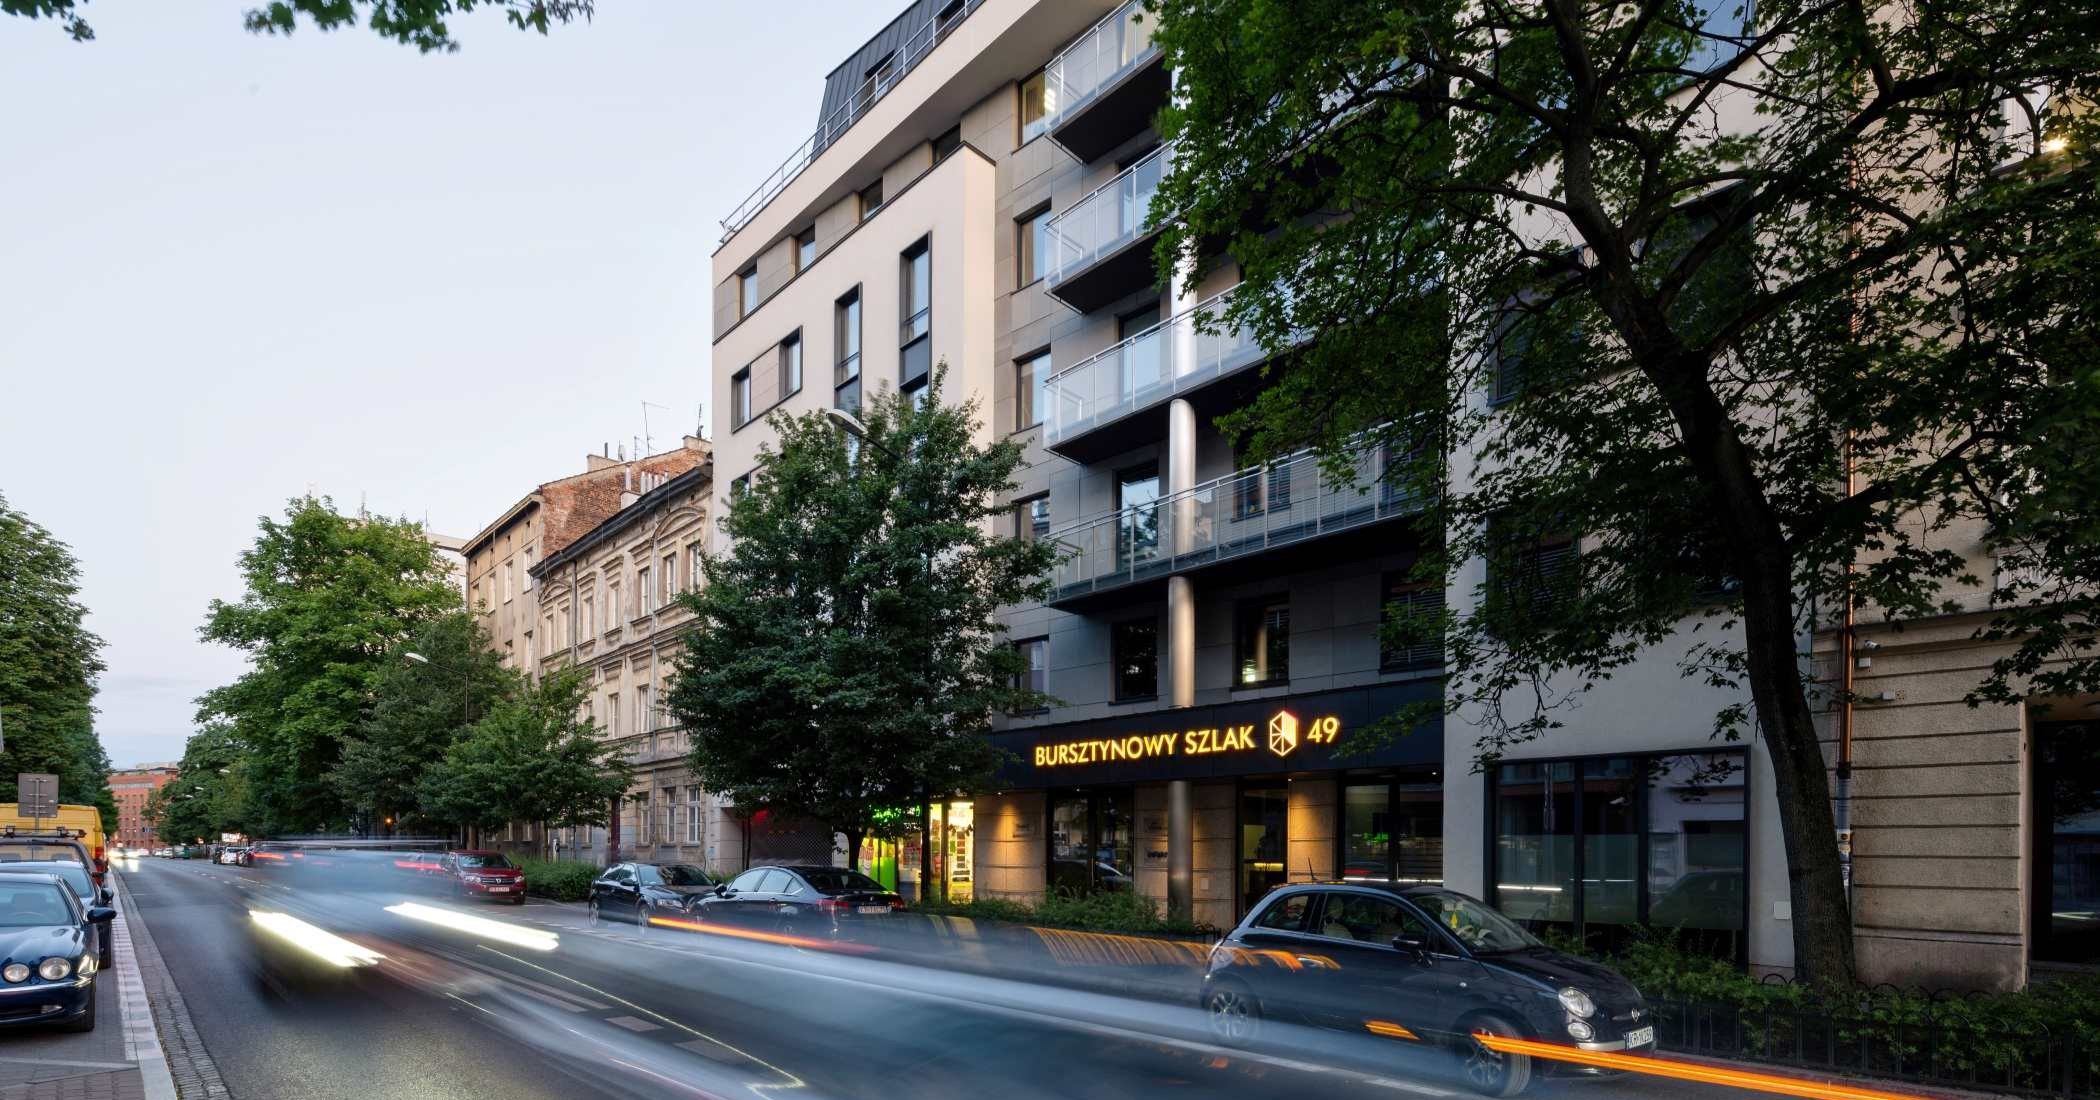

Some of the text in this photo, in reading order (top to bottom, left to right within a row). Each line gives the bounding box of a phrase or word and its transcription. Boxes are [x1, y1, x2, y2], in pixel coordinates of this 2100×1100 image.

[1035, 716, 1339, 766] BURSZTYNOWY SZLAK 49
